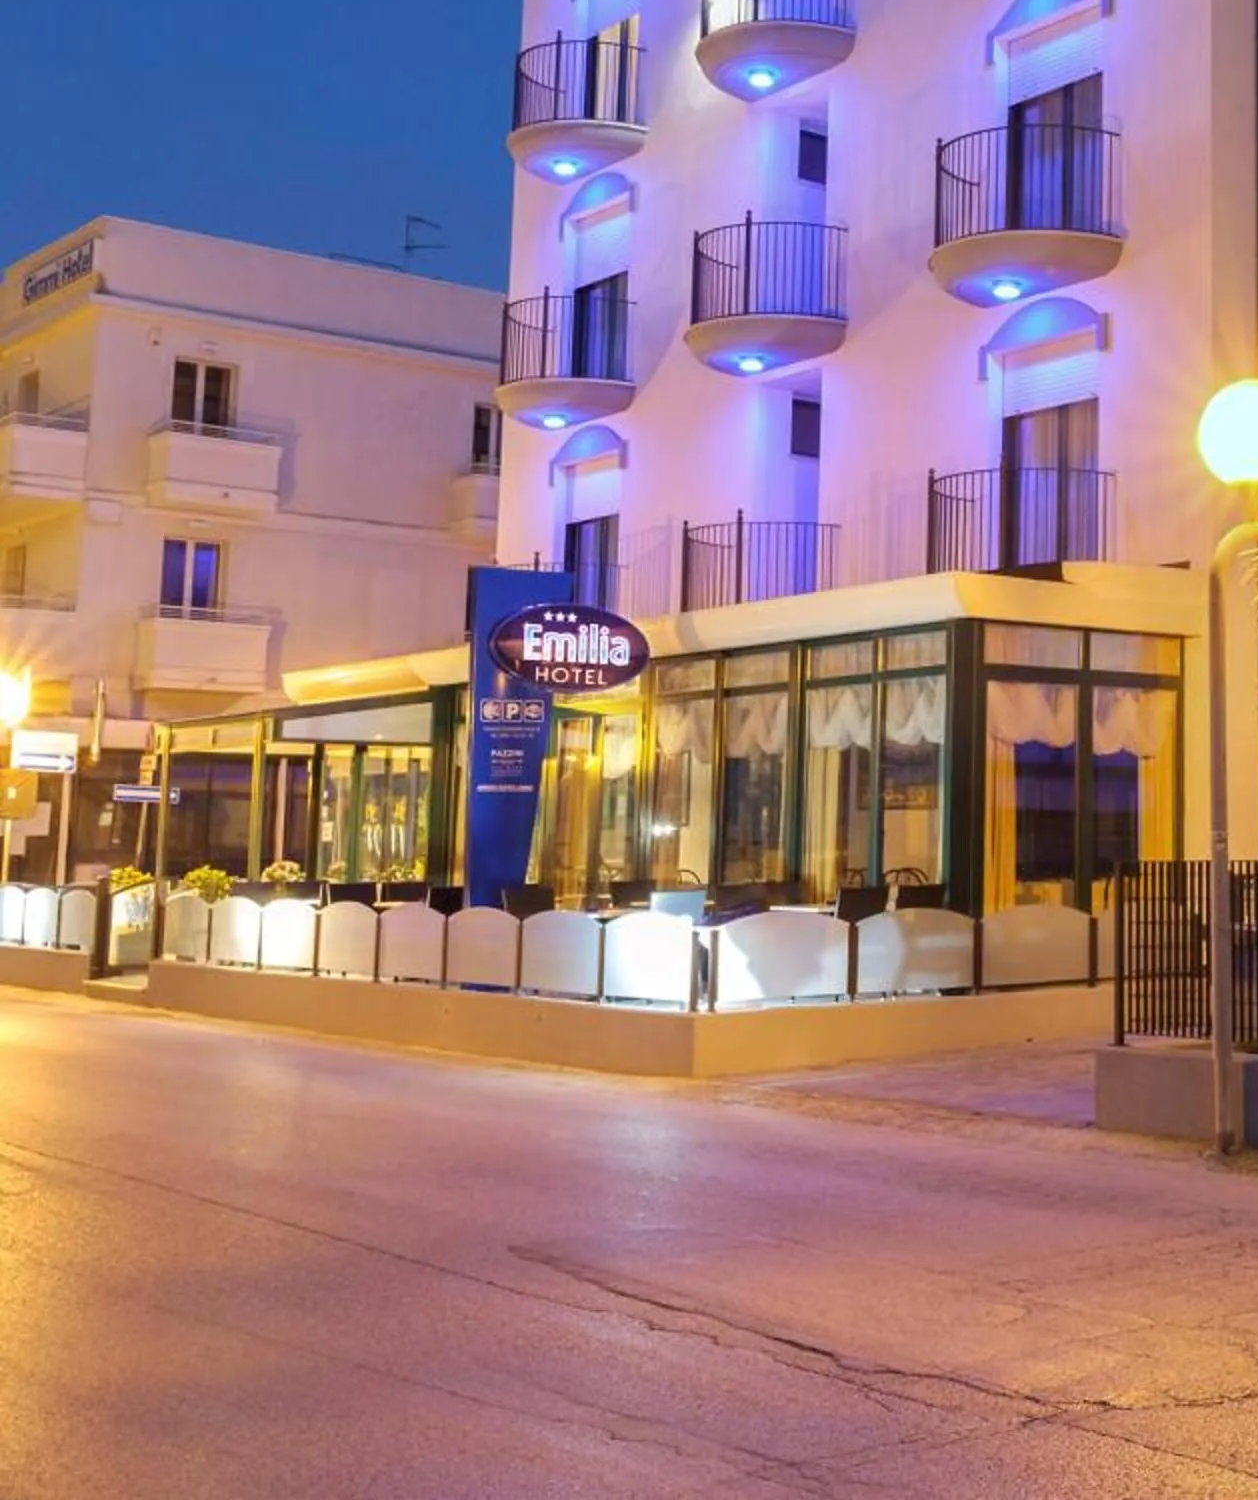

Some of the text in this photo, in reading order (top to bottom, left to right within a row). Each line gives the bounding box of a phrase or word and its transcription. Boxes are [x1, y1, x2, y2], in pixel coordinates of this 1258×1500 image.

[523, 622, 631, 666] Emilia
[535, 666, 608, 685] HOTEL
[506, 703, 519, 719] P
